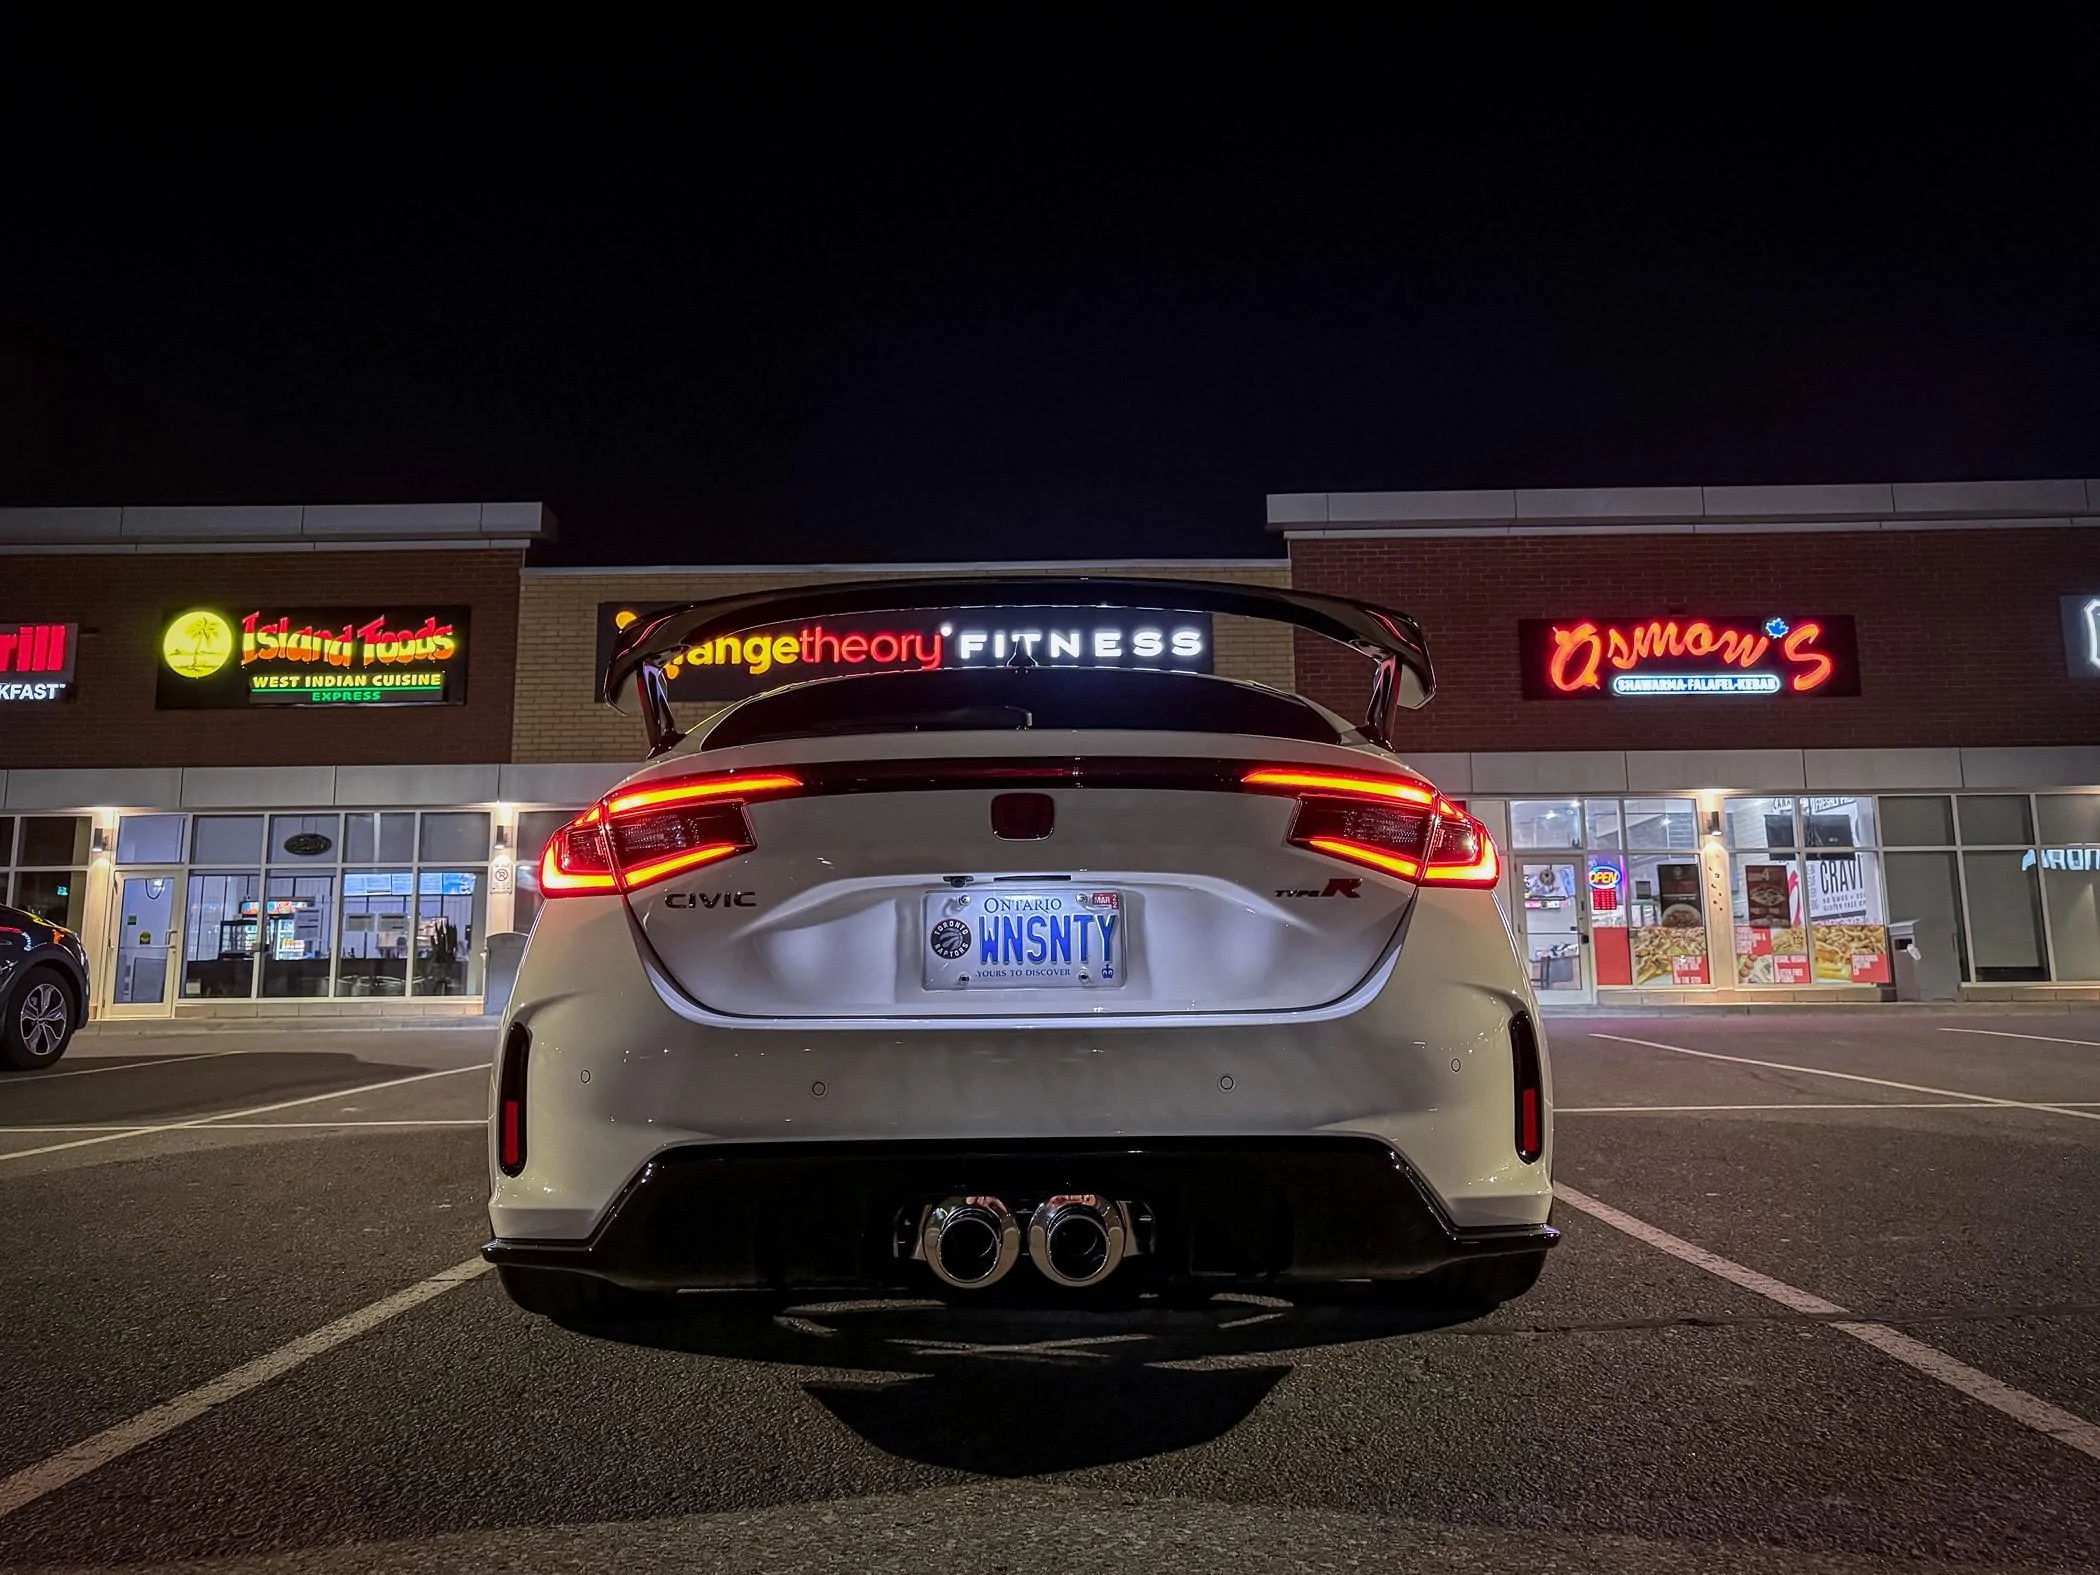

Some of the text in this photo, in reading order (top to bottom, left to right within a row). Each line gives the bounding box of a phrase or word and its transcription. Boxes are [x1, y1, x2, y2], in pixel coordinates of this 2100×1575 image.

[241, 611, 455, 667] Island Foods
[616, 611, 1201, 678] angetheory FITNESS
[253, 674, 441, 688] WEST INDIAN CUISINE
[312, 691, 381, 701] EXPRESS
[1590, 871, 1617, 884] OPEN
[1275, 878, 1362, 898] TYPE R
[664, 891, 757, 909] CIVIC
[1094, 896, 1111, 904] MAR
[934, 920, 969, 936] TORONTO
[979, 914, 1118, 966] WNSNTY
[934, 942, 969, 958] RAPTORS
[977, 968, 1071, 978] YOURS TO DISCOVER
